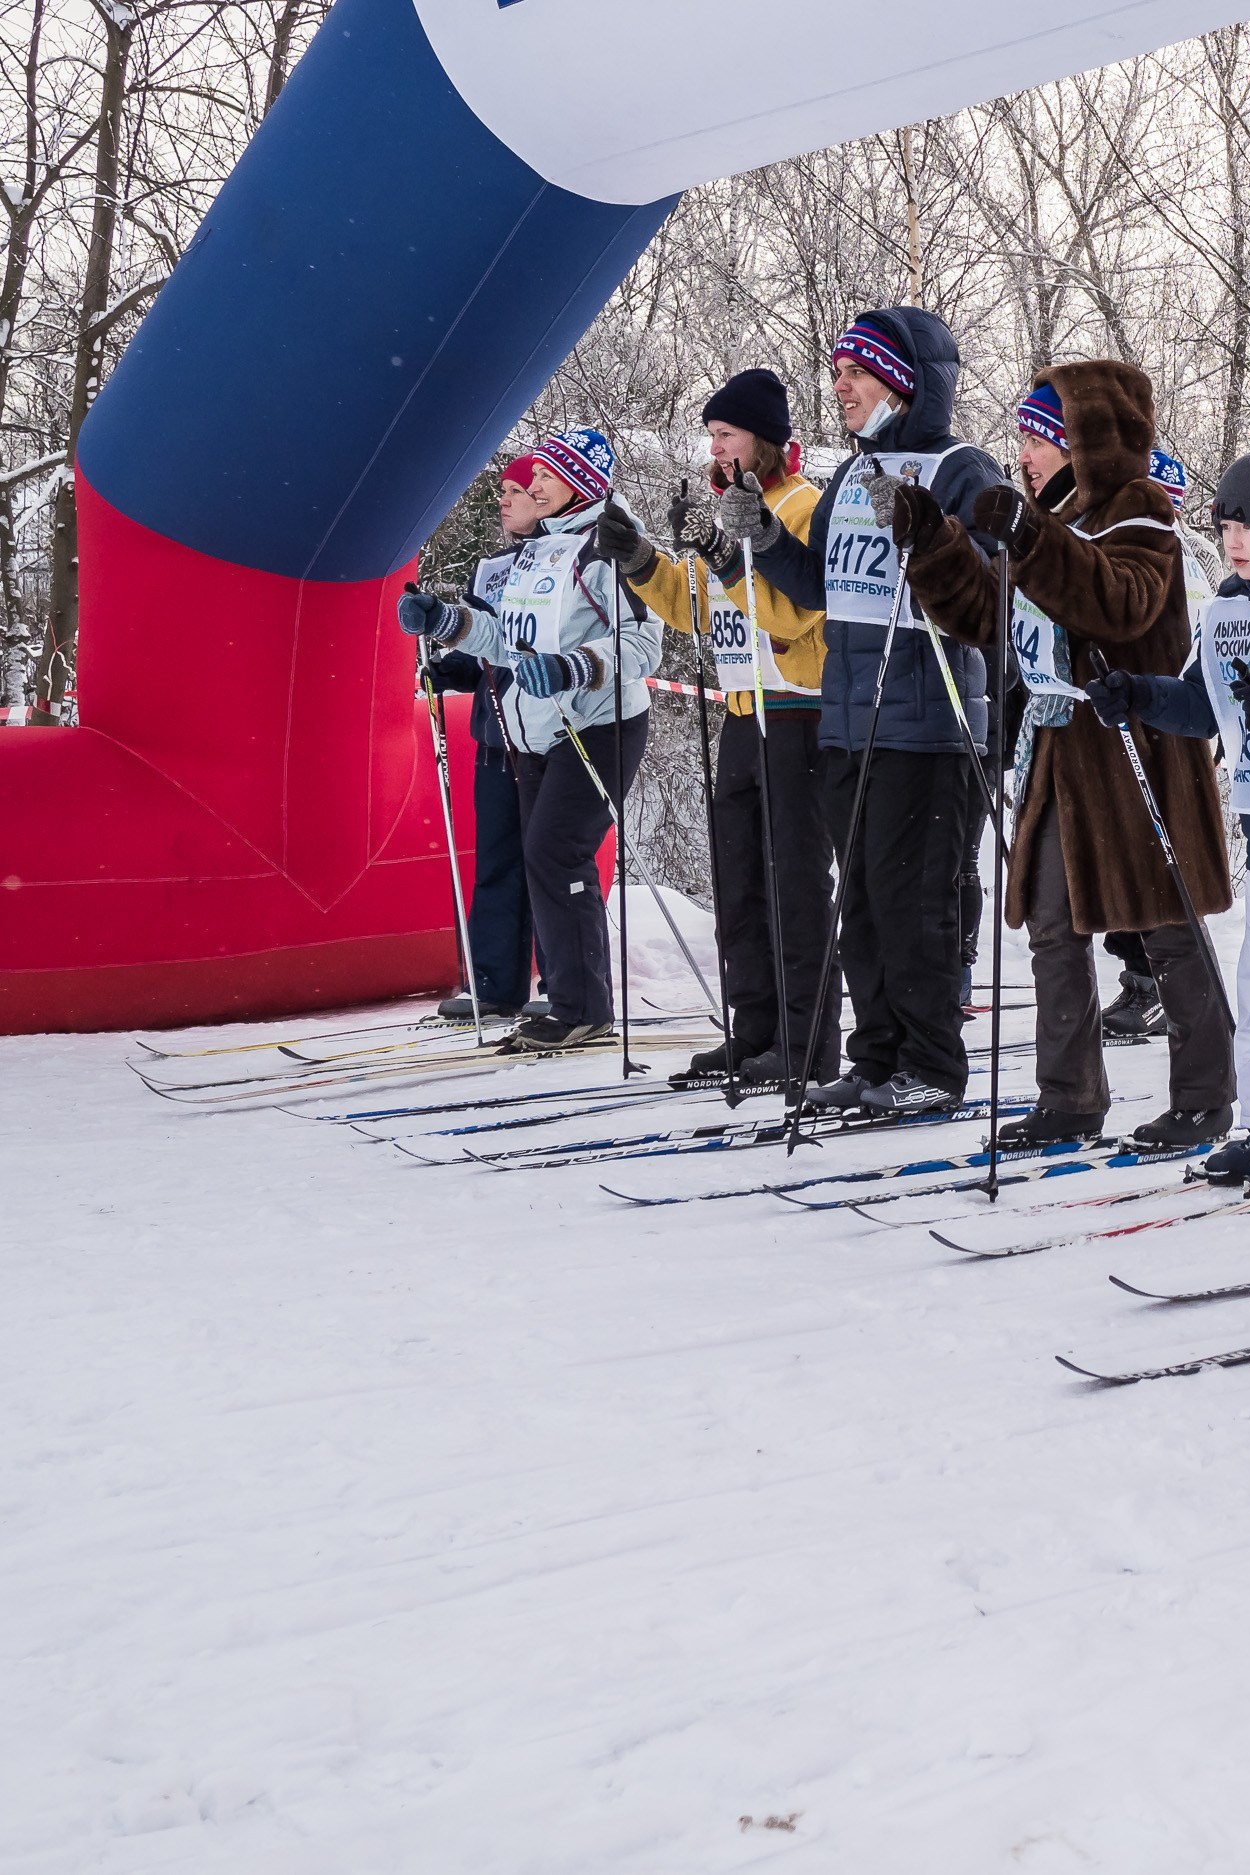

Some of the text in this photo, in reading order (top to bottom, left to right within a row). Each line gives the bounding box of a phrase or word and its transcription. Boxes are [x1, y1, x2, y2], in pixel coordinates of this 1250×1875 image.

[827, 532, 891, 578] 4172
[688, 555, 696, 592] NORDWA
[1122, 734, 1143, 777] NORDWAY
[687, 1080, 727, 1088] NORDWA
[952, 1111, 975, 1120] 190
[1000, 1149, 1043, 1161] NORDWAY
[1137, 1151, 1178, 1163] NORDWAY
